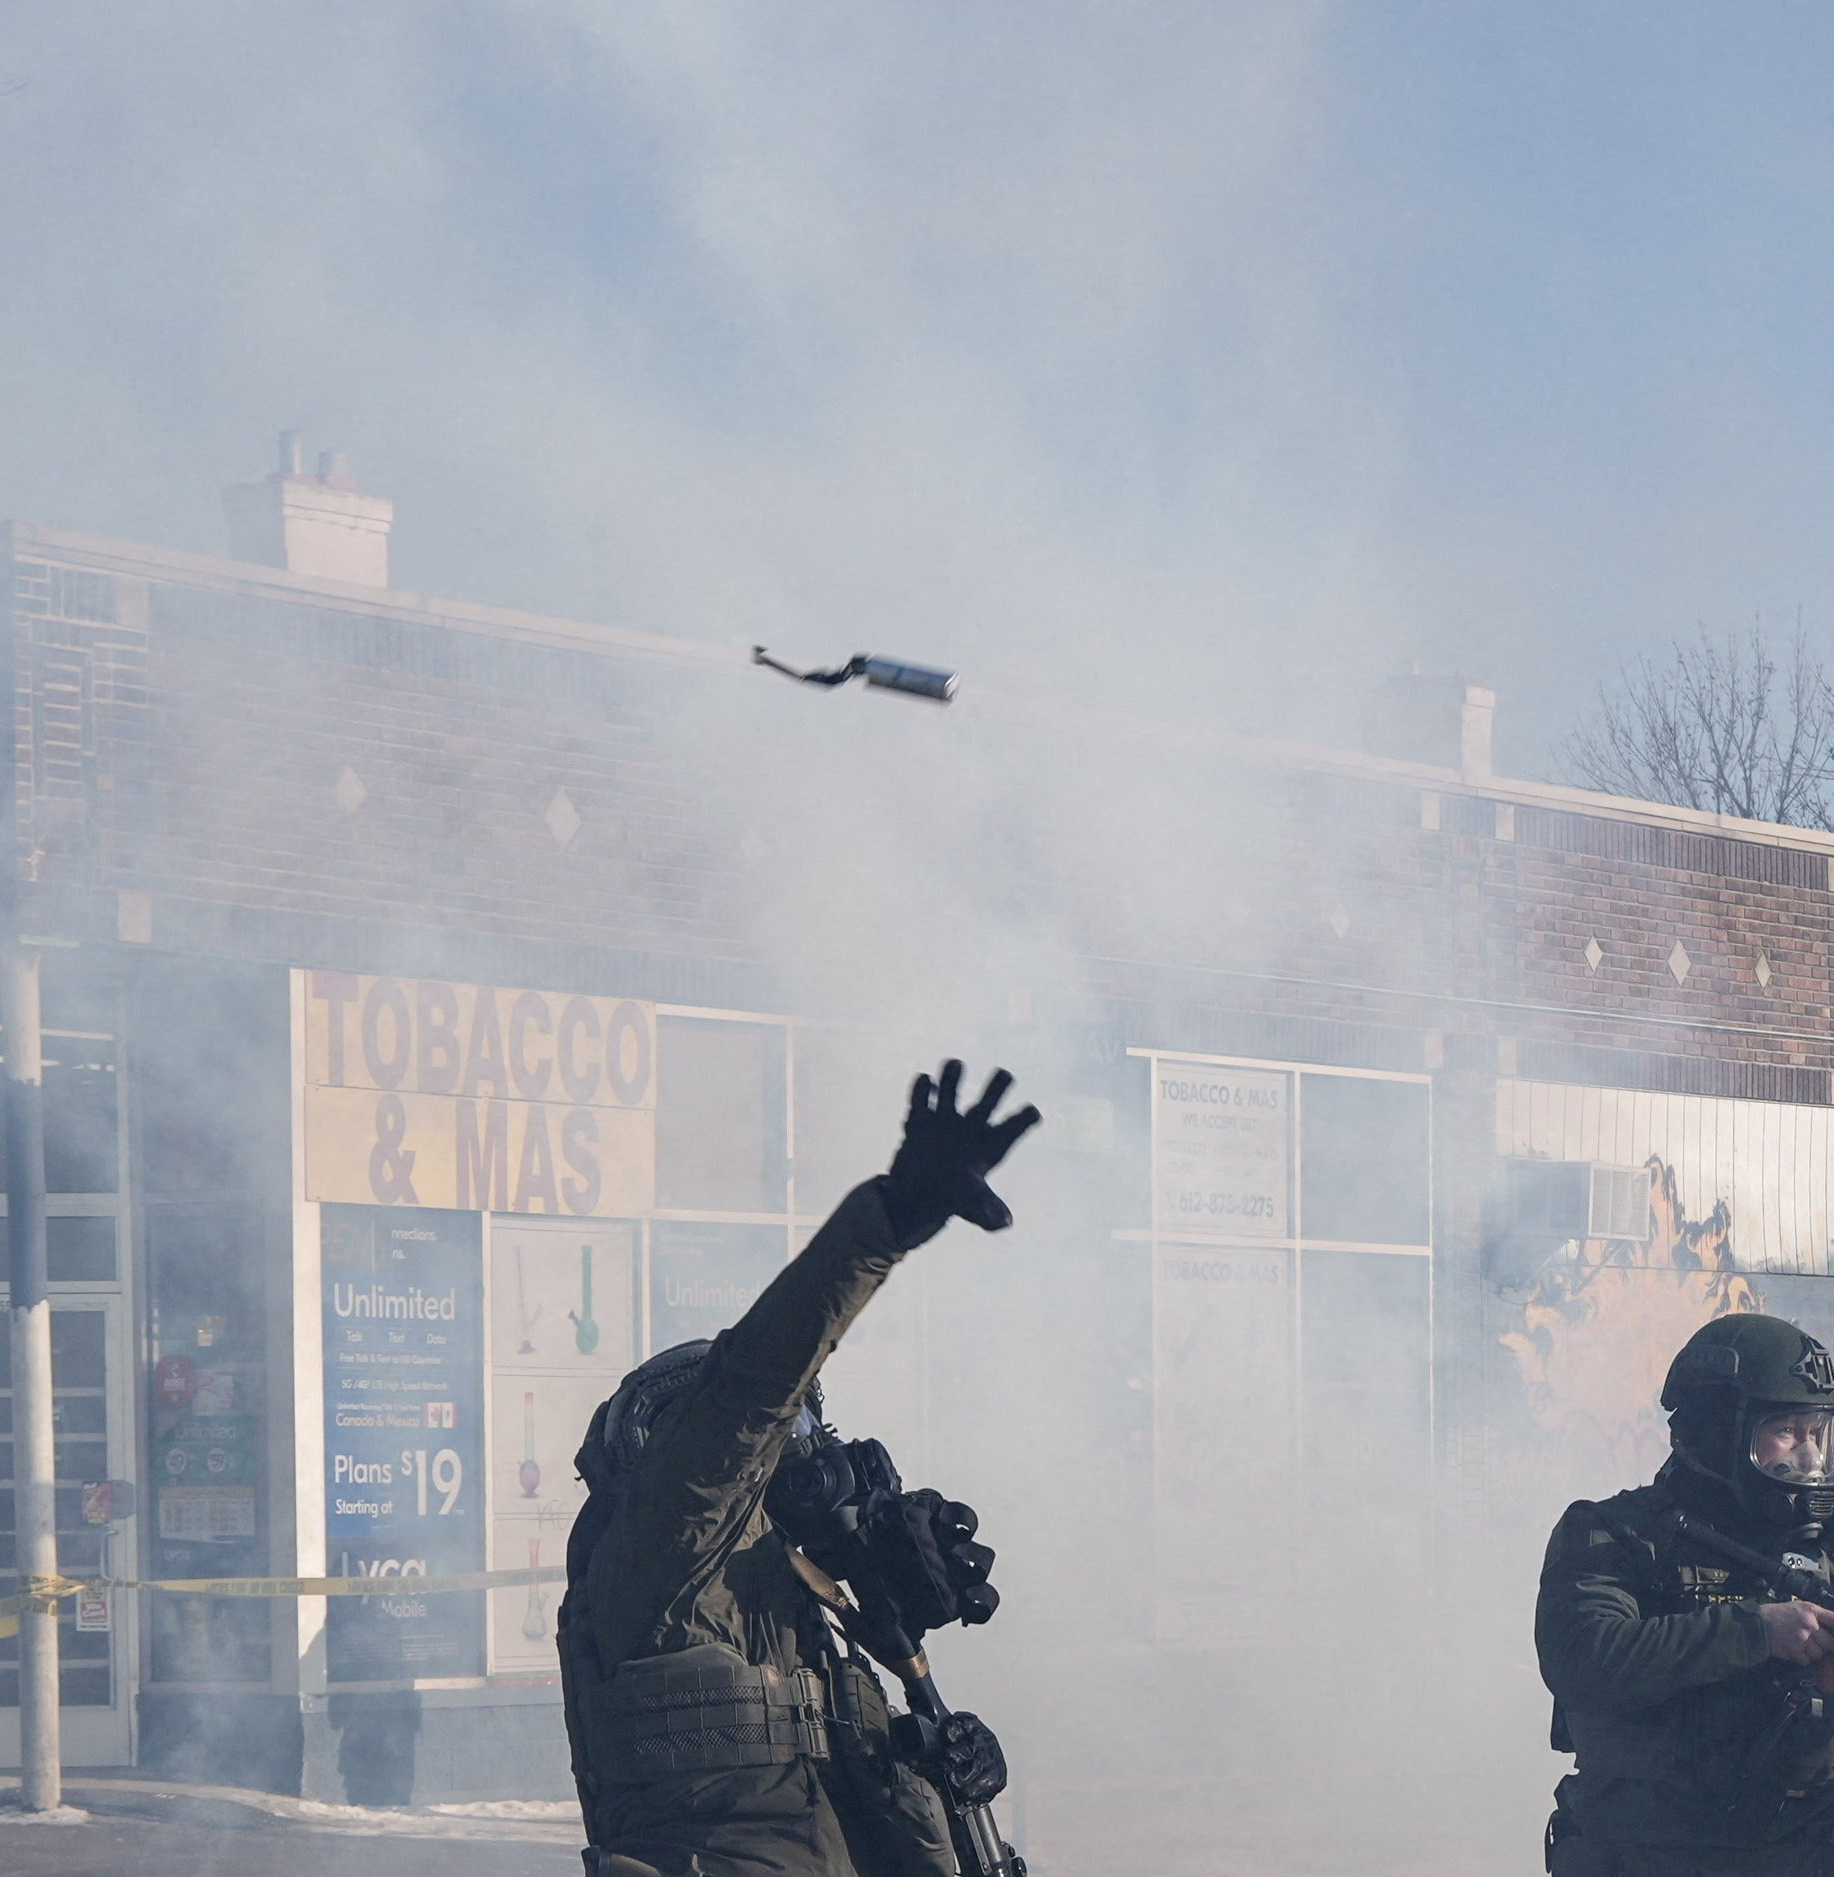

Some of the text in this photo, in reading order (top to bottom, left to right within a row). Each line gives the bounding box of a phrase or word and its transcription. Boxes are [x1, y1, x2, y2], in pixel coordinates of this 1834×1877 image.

[312, 970, 651, 1105] TOBACCO
[1160, 1079, 1278, 1109] TOBACCO & MAS
[369, 1094, 601, 1215] & MAS
[1162, 1260, 1231, 1282] TOBACCO
[334, 1283, 455, 1321] Unlimited
[346, 1330, 447, 1345] Talk Text Data
[336, 1412, 374, 1427] Canada
[335, 1448, 462, 1516] Plans $19
[336, 1499, 393, 1518] Starting at
[381, 1600, 426, 1618] Mobile
